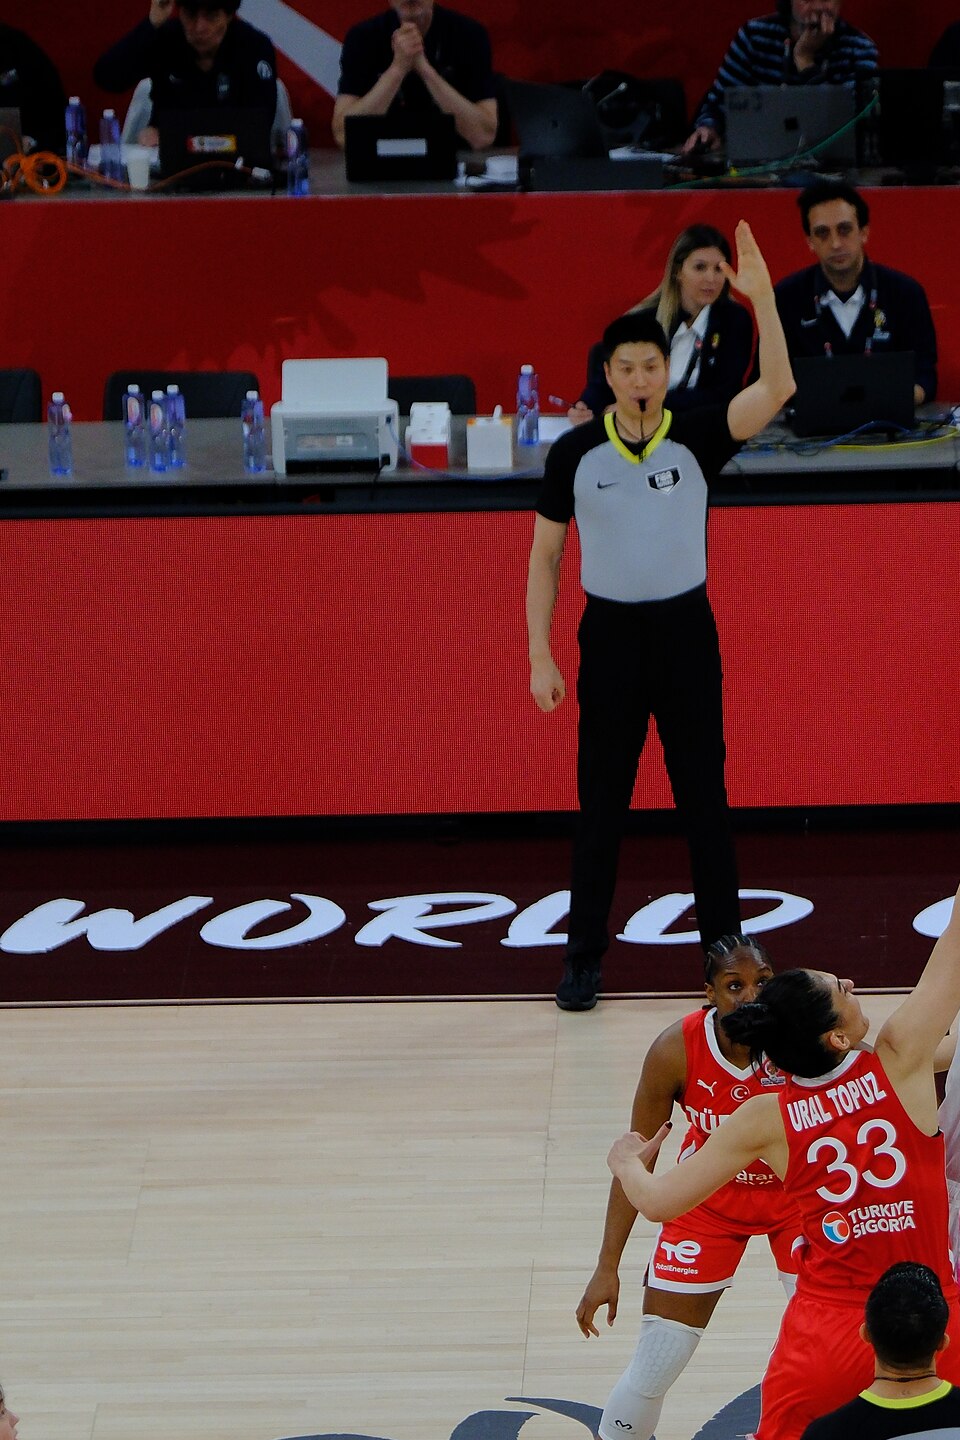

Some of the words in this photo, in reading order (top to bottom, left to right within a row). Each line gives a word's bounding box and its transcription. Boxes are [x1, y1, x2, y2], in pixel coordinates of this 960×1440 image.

[0, 888, 816, 954] WORLD
[786, 1094, 833, 1132] URAL
[826, 1071, 888, 1117] TOPUZ
[807, 1118, 907, 1204] 33
[655, 1262, 699, 1276] TotalEnergies
